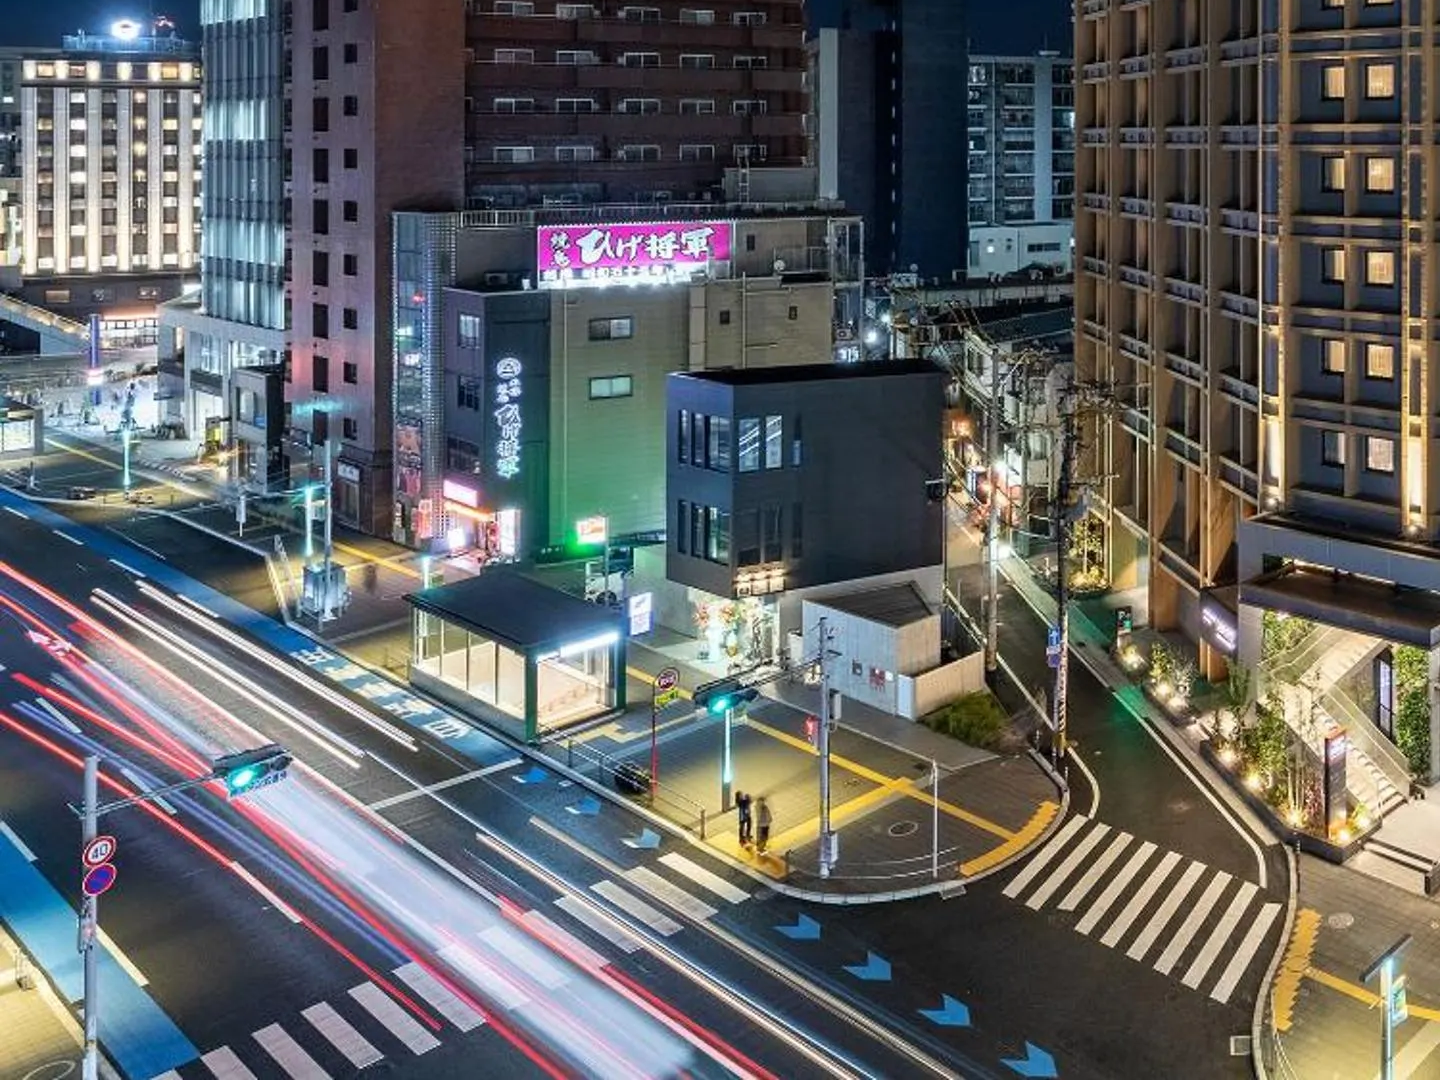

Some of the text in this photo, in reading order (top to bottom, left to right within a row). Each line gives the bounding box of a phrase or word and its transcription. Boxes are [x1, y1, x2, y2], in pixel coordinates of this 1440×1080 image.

[576, 227, 715, 264] ひげ将軍
[90, 842, 109, 860] 40
